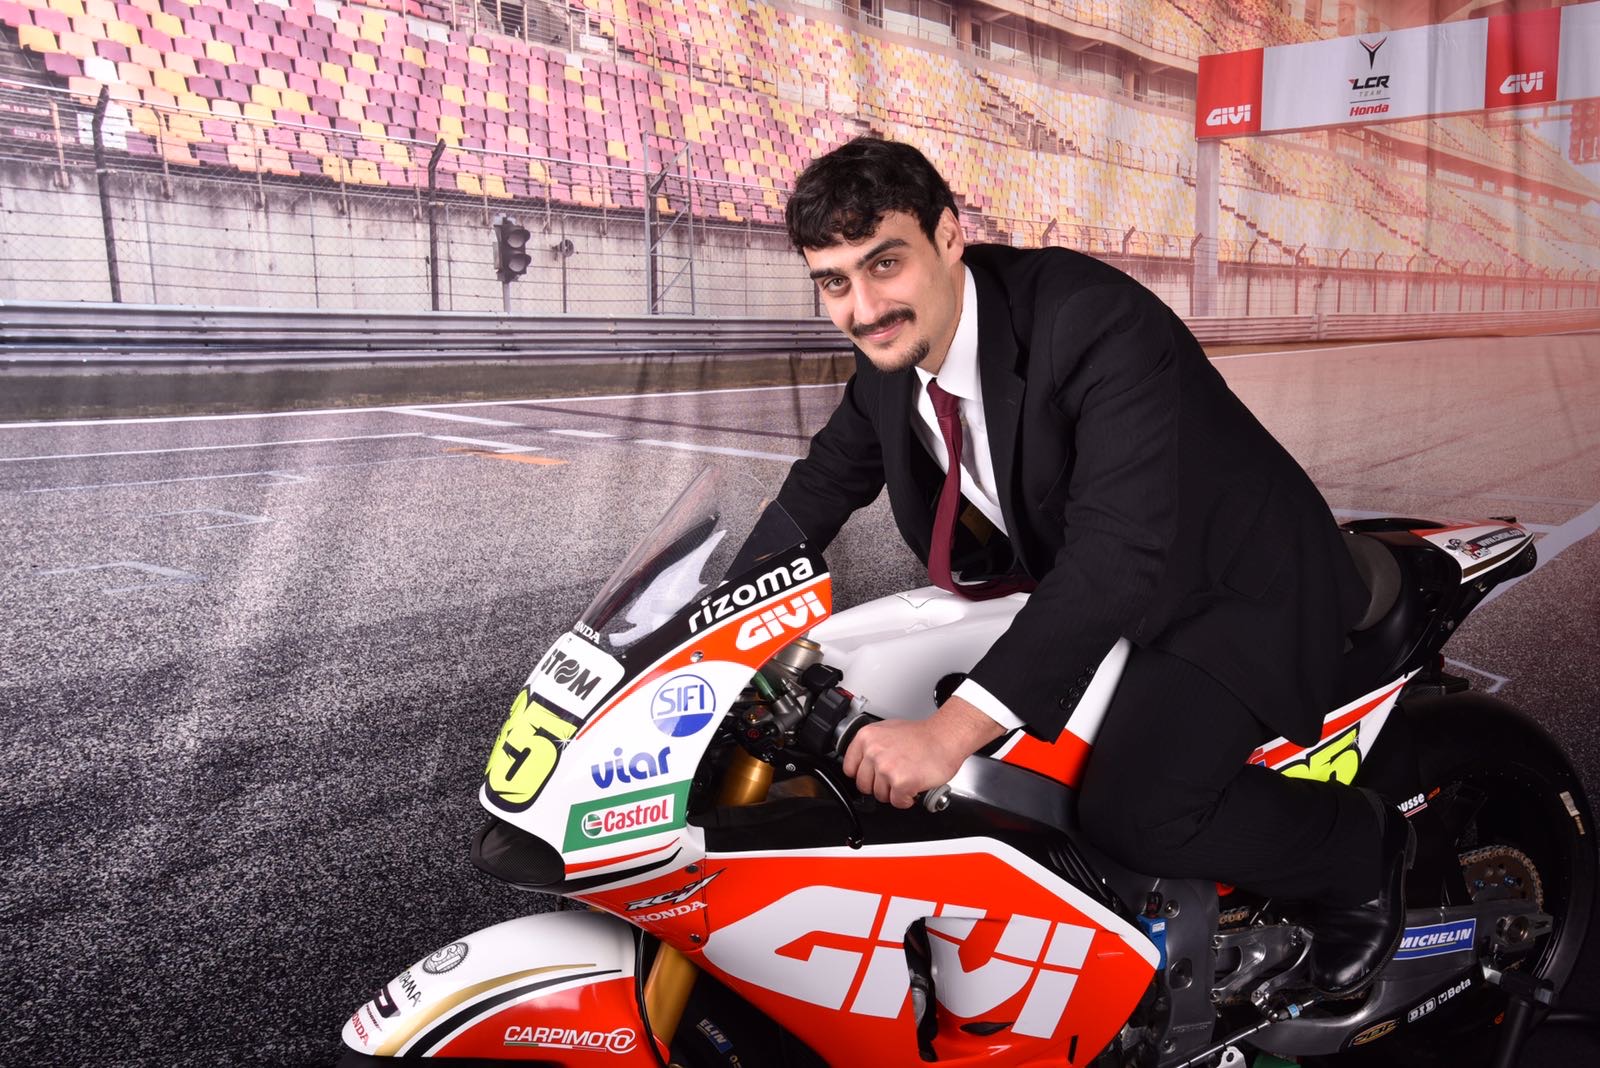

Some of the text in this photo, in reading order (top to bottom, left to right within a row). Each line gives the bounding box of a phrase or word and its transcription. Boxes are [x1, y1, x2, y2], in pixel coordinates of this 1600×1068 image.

[1349, 75, 1390, 90] LCR
[1499, 71, 1544, 94] GIVI
[1206, 104, 1251, 126] GIVI
[1350, 104, 1389, 117] Honda
[688, 556, 814, 633] rizoma
[735, 590, 826, 650] GIVI
[657, 685, 705, 716] SIFI
[591, 746, 671, 789] viar
[603, 800, 668, 833] Castrol
[631, 901, 708, 922] HONDA
[702, 885, 1096, 1039] GIVI
[1447, 978, 1472, 999] Beta
